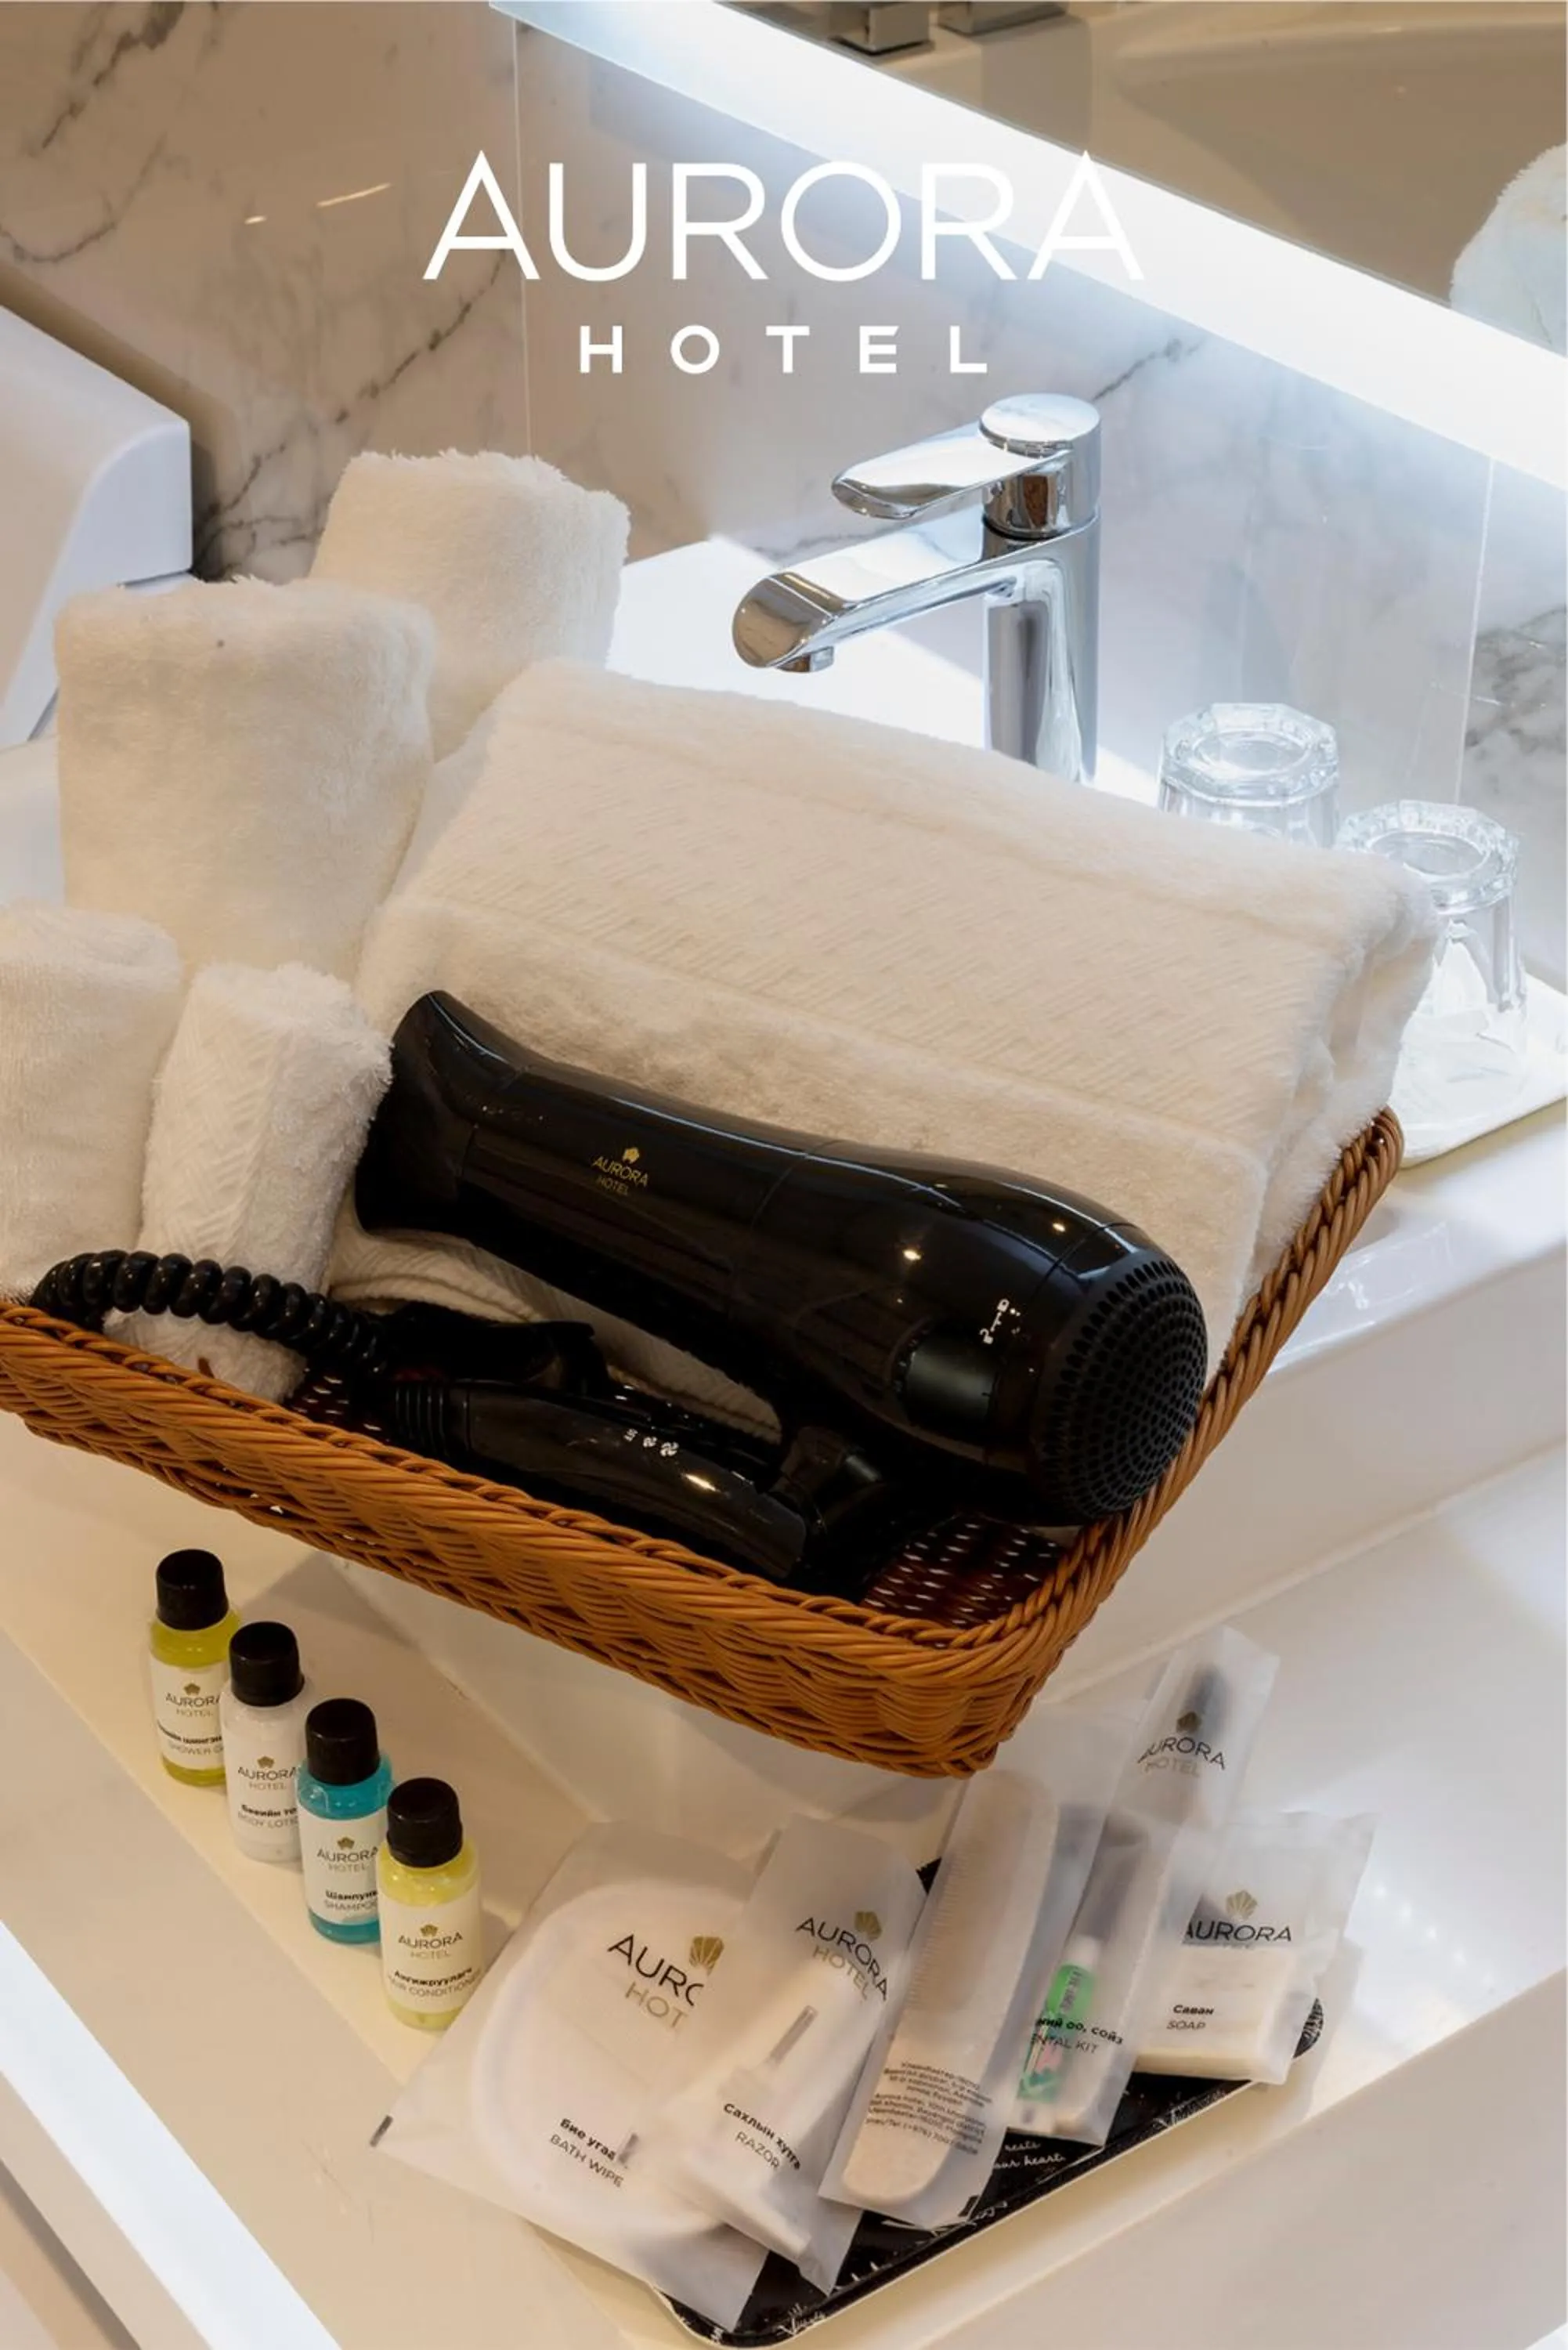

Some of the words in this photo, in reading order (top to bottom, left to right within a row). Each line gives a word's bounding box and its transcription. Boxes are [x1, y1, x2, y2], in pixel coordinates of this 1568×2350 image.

[591, 1155, 649, 1188] AURORA
[1136, 1736, 1227, 1771] AURORA
[398, 1931, 464, 1950] AURORA
[795, 1916, 889, 2003] AURORA
[811, 1944, 869, 2001] HOTEL
[1166, 2019, 1207, 2031] SOAP
[1075, 2040, 1099, 2054] KIT
[723, 2102, 775, 2139] Сахлын
[550, 2133, 587, 2163] BATH
[588, 2158, 624, 2188] WIPE
[735, 2130, 780, 2170] RAZOR
